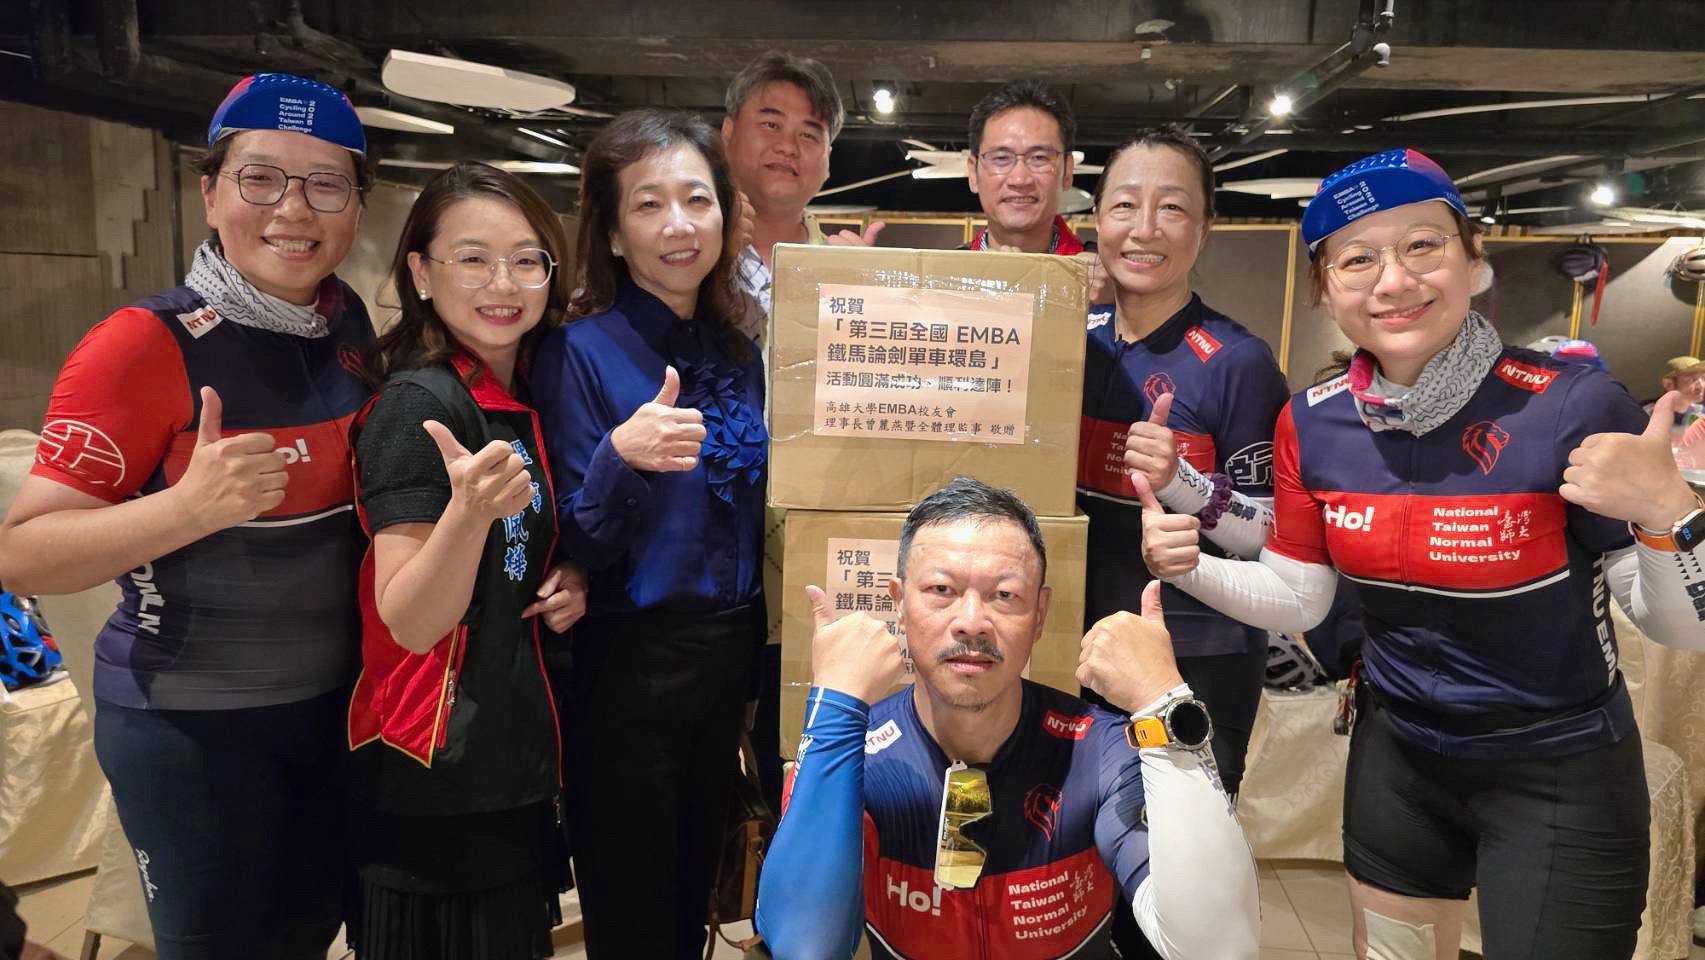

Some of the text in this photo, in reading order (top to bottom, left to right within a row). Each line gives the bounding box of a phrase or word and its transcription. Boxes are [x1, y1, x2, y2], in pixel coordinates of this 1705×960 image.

[279, 111, 306, 119] Around
[280, 104, 307, 113] Cycling
[279, 117, 304, 125] Taiwan
[829, 297, 865, 316] 祝賀
[956, 326, 1020, 345] EMBA
[1188, 330, 1214, 354] NTNU
[1502, 364, 1550, 385] NTNU
[825, 401, 957, 419] 高雄大學EMBA校友會
[989, 423, 1015, 436] 敬贈
[274, 438, 311, 465] o!
[1324, 504, 1375, 532] Ho!
[1433, 506, 1499, 517] National
[1432, 522, 1489, 532] Taiwan
[1429, 537, 1493, 547] Normal
[837, 549, 871, 566] 祝賀
[1429, 550, 1520, 563] University
[835, 592, 897, 612] 鐵馬論
[866, 726, 895, 747] TNU
[1008, 871, 1069, 896] National
[886, 873, 942, 916] Ho!
[1011, 890, 1065, 910] Taiwan
[1013, 904, 1069, 926] Normal
[1015, 904, 1088, 940] University
